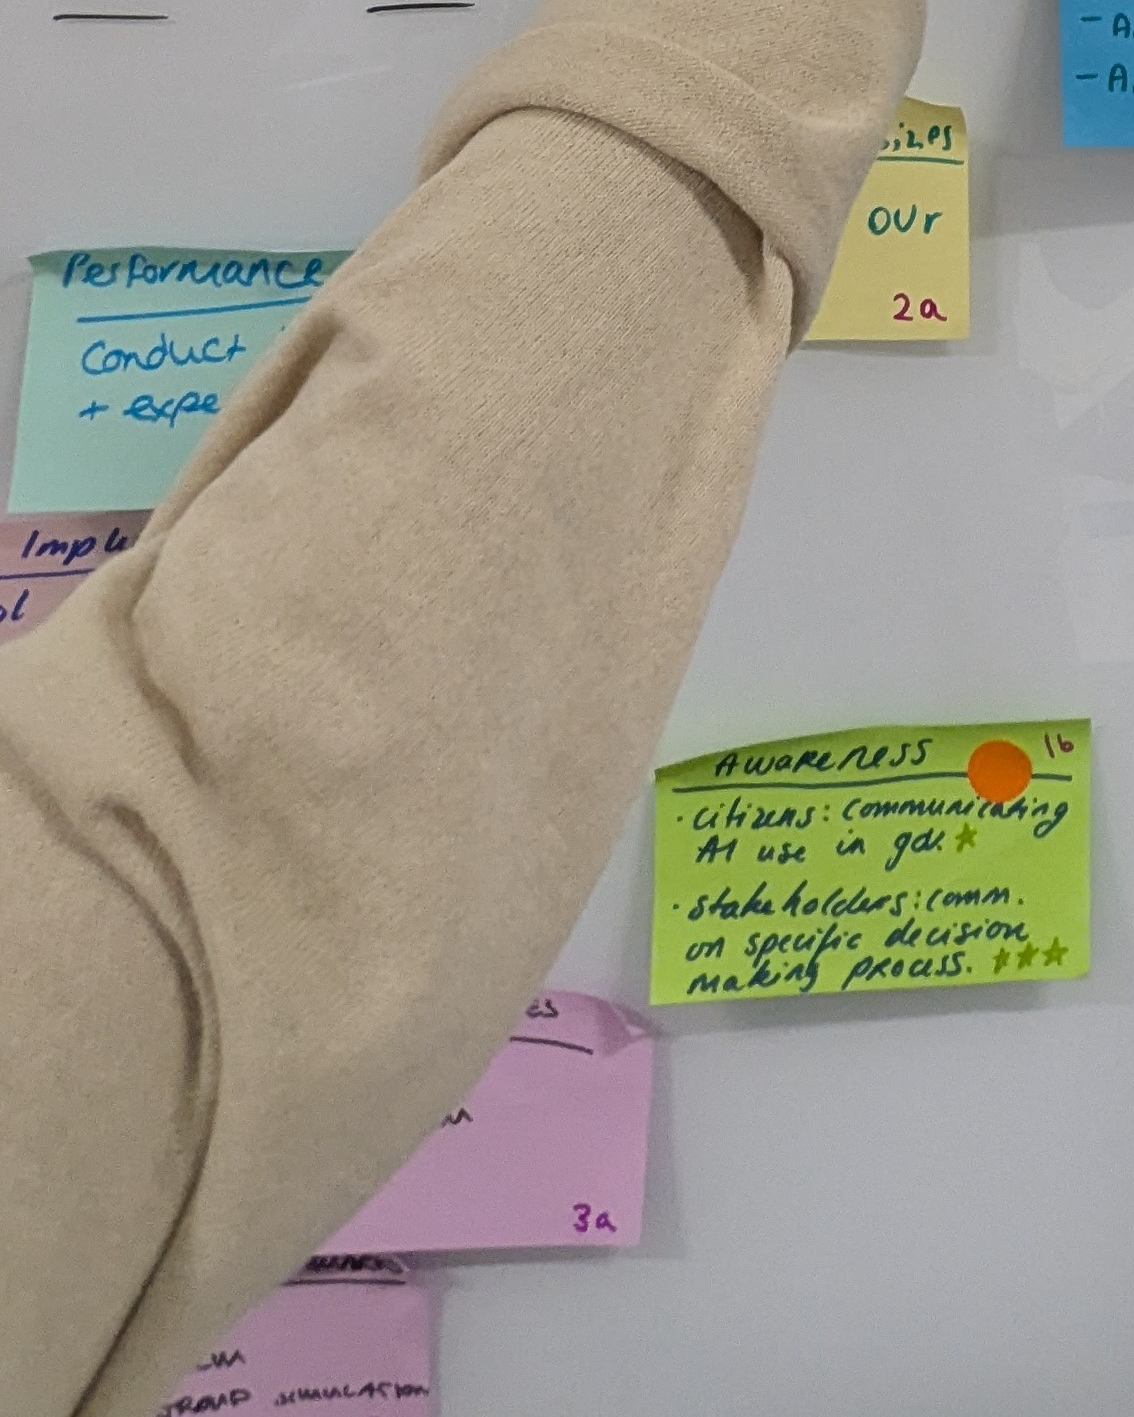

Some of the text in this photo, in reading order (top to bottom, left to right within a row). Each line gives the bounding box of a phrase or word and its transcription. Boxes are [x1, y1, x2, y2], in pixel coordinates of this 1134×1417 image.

[62, 253, 324, 288] Performance
[893, 293, 947, 321] 2a
[122, 391, 221, 428] expe
[696, 835, 738, 864] AI
[757, 844, 807, 864] use
[836, 829, 865, 856] in
[686, 918, 1030, 968] on specific decision
[687, 960, 820, 996] making
[573, 1202, 617, 1232] 3a
